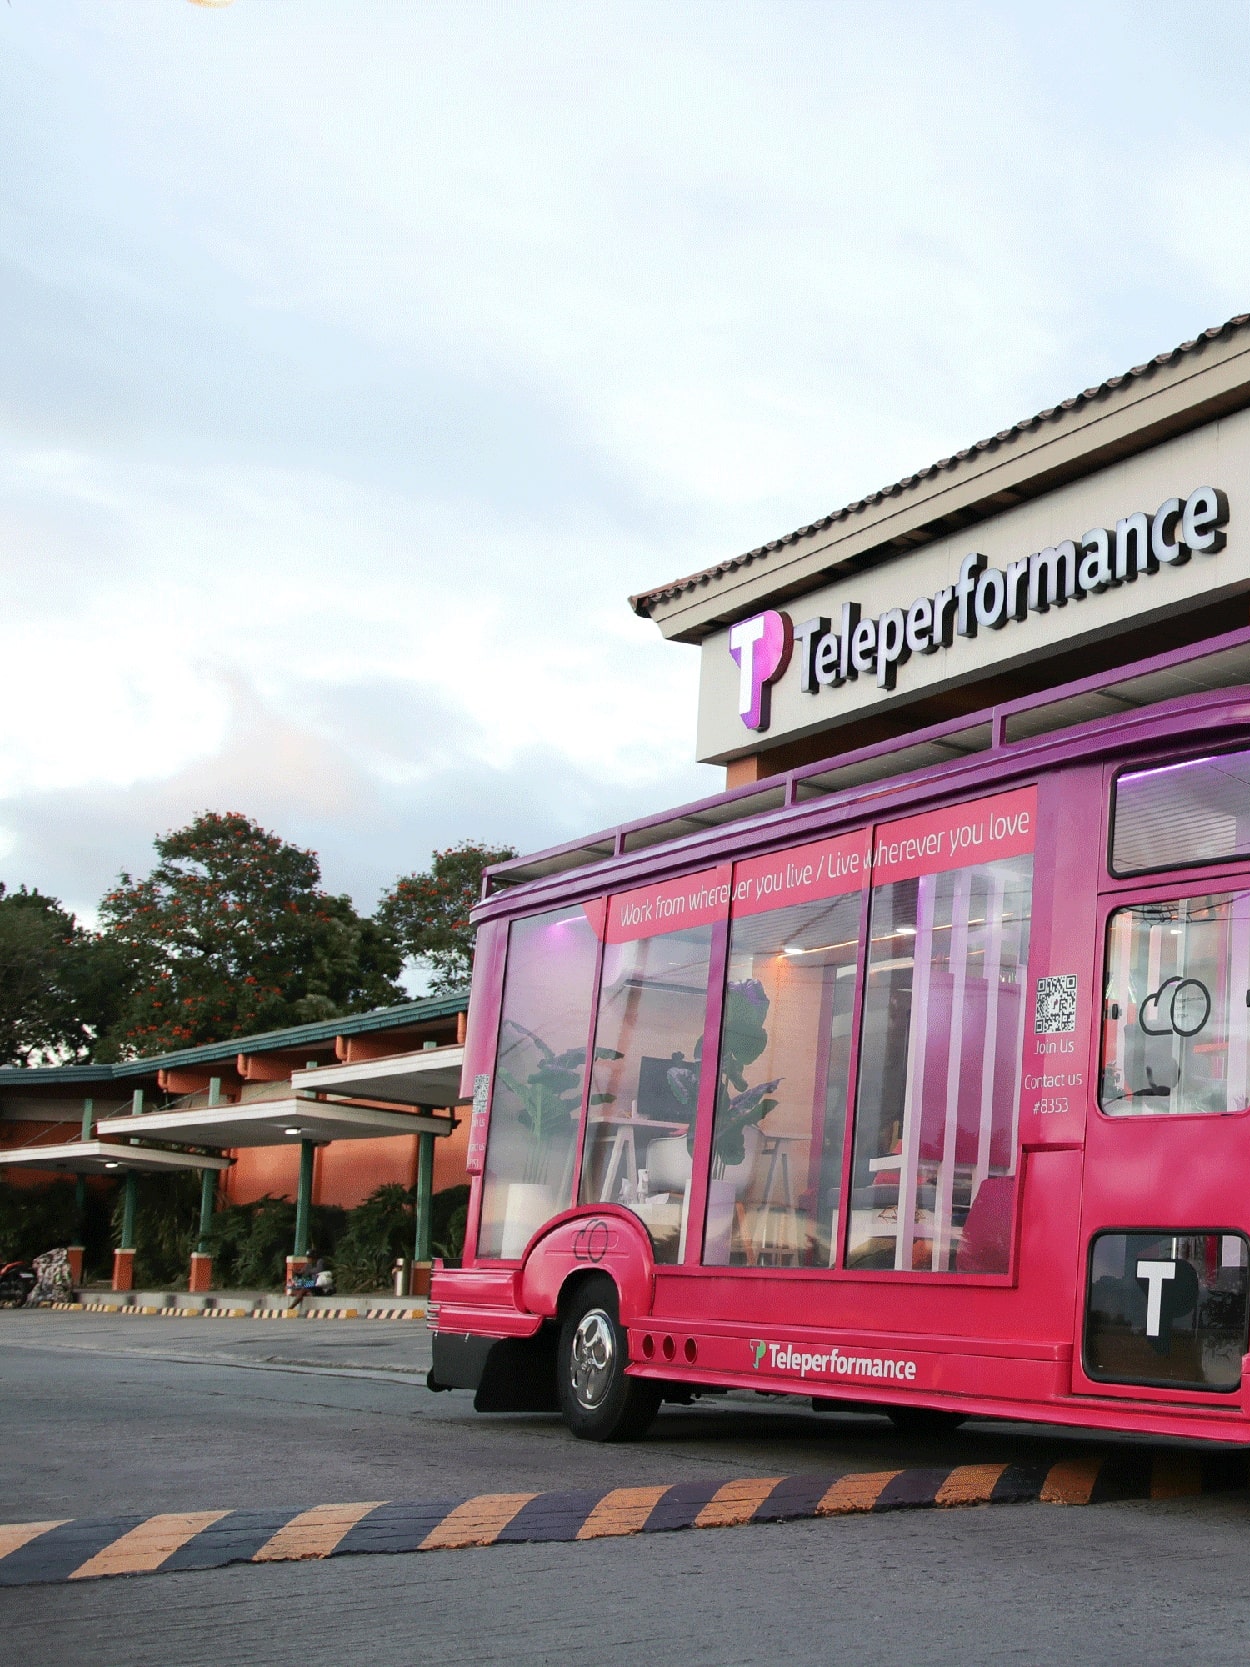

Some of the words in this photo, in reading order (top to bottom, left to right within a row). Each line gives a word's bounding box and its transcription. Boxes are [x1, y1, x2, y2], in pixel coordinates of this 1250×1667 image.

[793, 486, 1230, 694] Teleperformance
[620, 902, 653, 927] Work
[656, 895, 686, 919] from
[689, 878, 753, 911] wherever
[756, 872, 783, 900] you
[786, 863, 813, 889] live
[816, 855, 825, 880] /
[827, 851, 859, 879] Live
[863, 830, 946, 870] wherever
[950, 823, 984, 857] you
[989, 811, 1030, 841] love
[1033, 1039, 1057, 1055] Join
[1060, 1038, 1074, 1053] Us
[1024, 1073, 1065, 1090] Contact
[1068, 1073, 1083, 1086] us
[1033, 1098, 1069, 1115] #8353
[768, 1343, 917, 1380] Teleperformance
